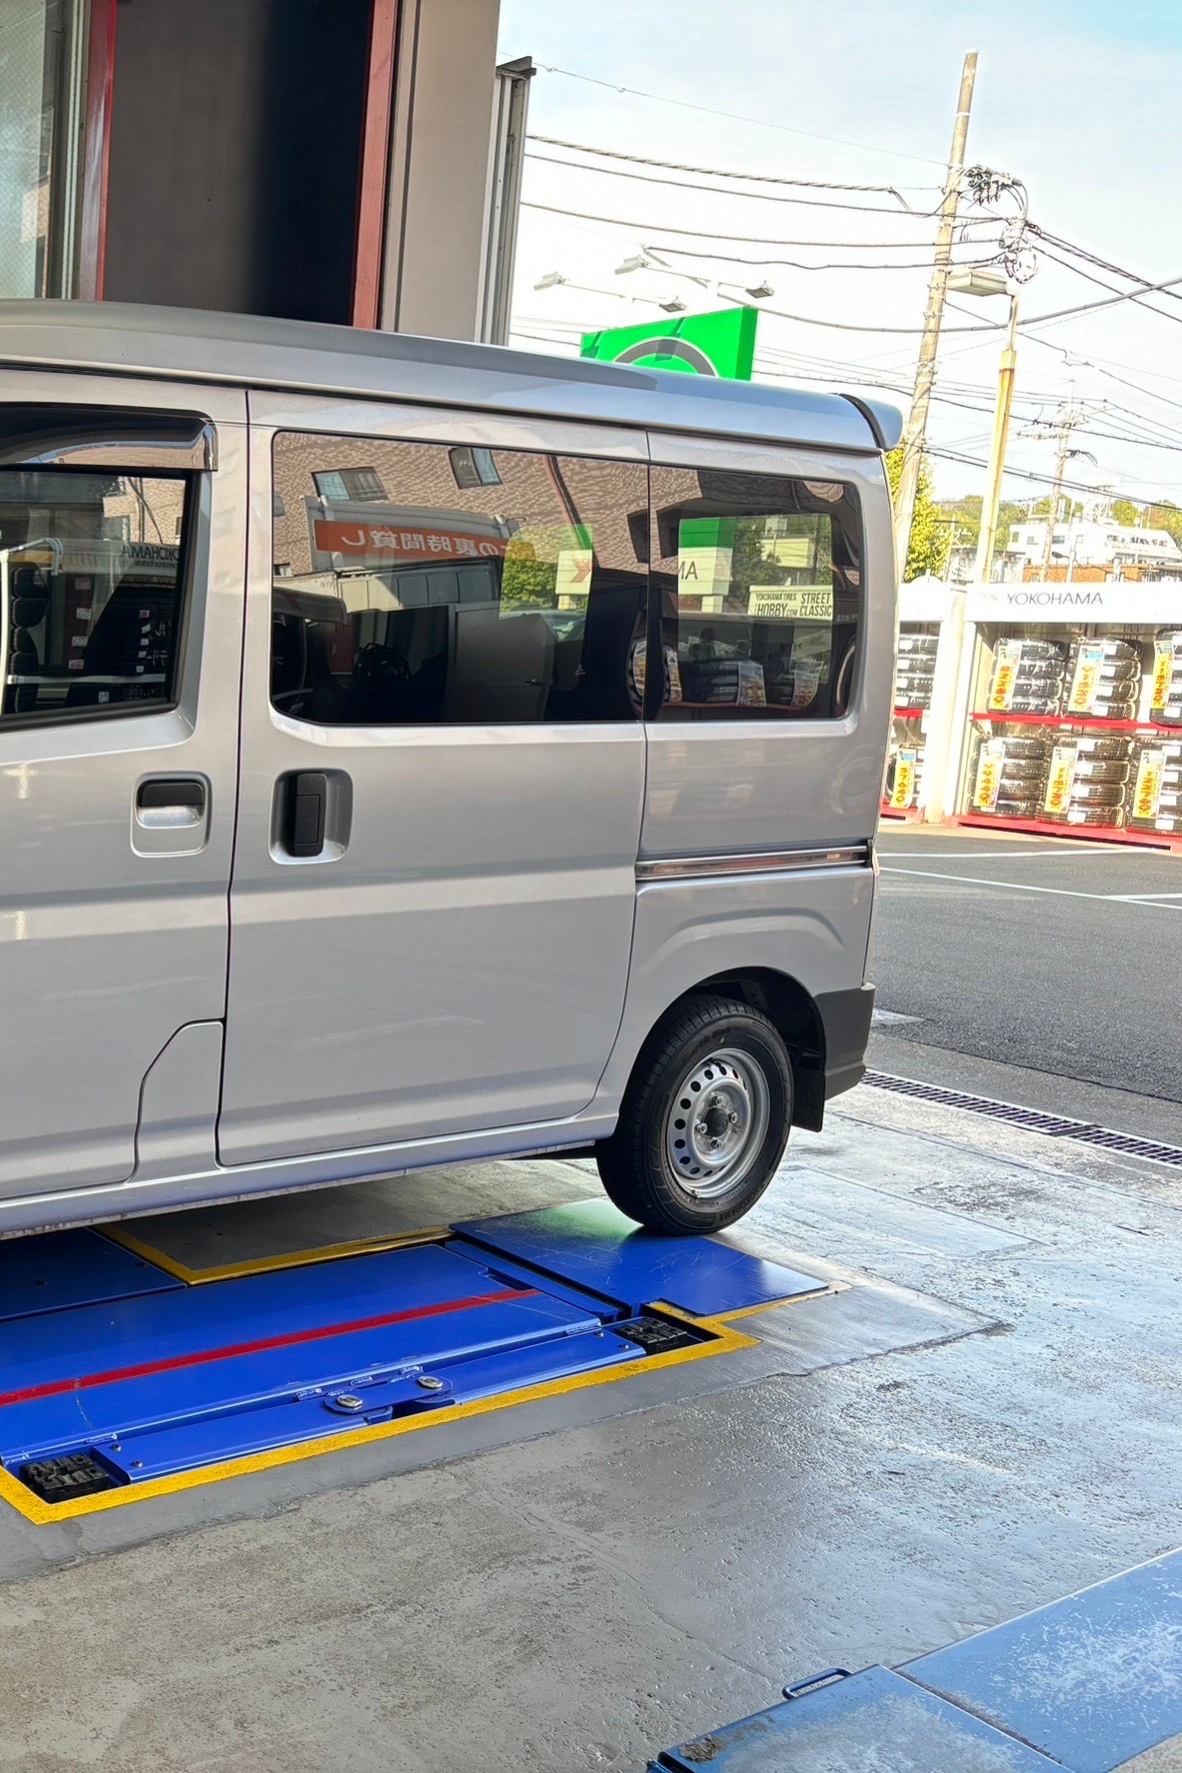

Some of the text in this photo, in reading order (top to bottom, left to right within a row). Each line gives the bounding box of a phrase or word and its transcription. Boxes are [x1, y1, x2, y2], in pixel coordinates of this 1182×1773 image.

[801, 592, 831, 604] STREET
[1007, 591, 1103, 606] YOKOHAMA
[799, 605, 832, 617] CLASSIC
